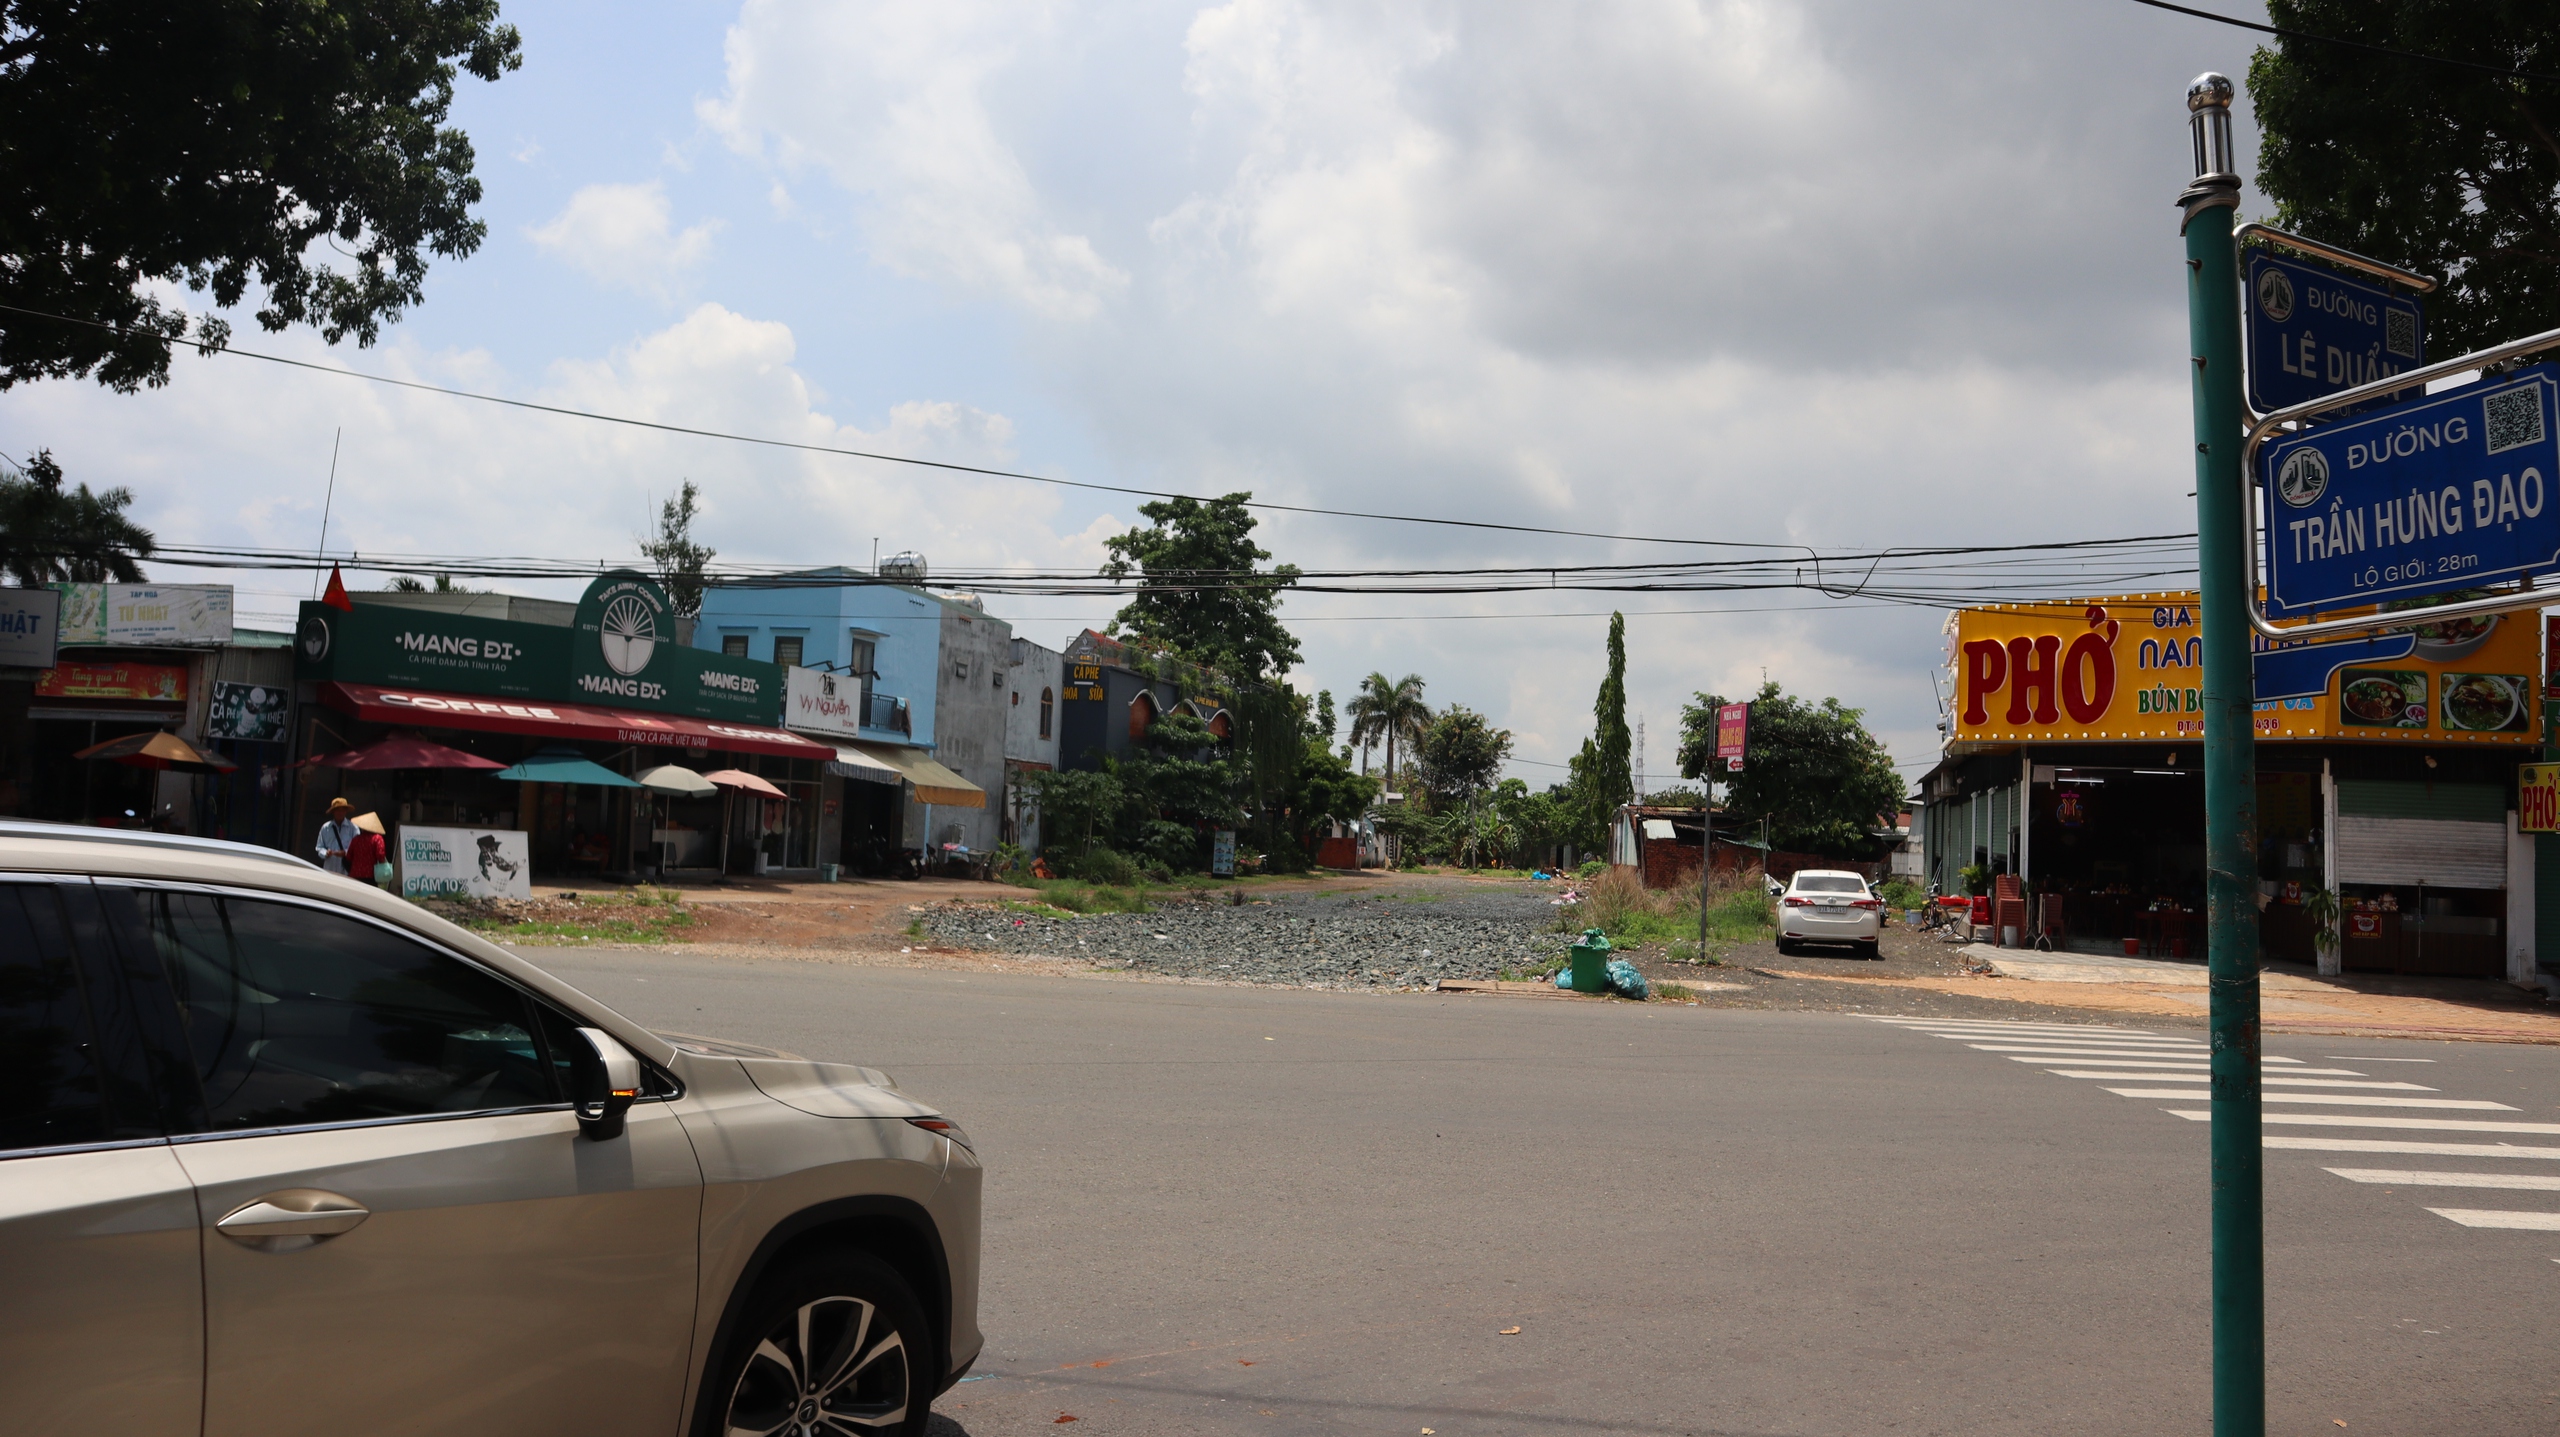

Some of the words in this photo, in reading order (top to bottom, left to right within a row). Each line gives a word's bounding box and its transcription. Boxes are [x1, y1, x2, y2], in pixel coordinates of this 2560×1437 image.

[2308, 286, 2377, 326] ĐƯỜNG
[2282, 330, 2317, 379] LÊ
[2327, 341, 2400, 401] DUẨN
[2347, 416, 2469, 470] ĐƯỜNG
[2289, 495, 2366, 565] TRẦN
[2374, 485, 2463, 548] HƯNG
[2473, 466, 2543, 533] ĐẠO
[2353, 565, 2378, 588] LỘ
[2437, 554, 2479, 575] 28m
[598, 585, 617, 603] TAKE
[617, 582, 638, 592] AWAY
[2153, 606, 2193, 629] GIA
[404, 631, 478, 657] MANG
[483, 640, 514, 661] ĐI
[1073, 664, 1084, 679] CÀ
[1085, 663, 1100, 680] PHÊ
[1962, 606, 2120, 726] PHỞ
[584, 674, 638, 697] MANG
[640, 681, 661, 700] ĐI
[703, 670, 740, 691] MANG
[740, 676, 756, 694] ĐI
[1063, 686, 1078, 701] HOA
[1089, 684, 1103, 701] SỮA
[379, 694, 560, 720] COFFEE
[800, 694, 813, 713] Vy
[2138, 682, 2181, 713] BÚN
[691, 736, 708, 747] NAM
[2522, 773, 2557, 829] PHỞ
